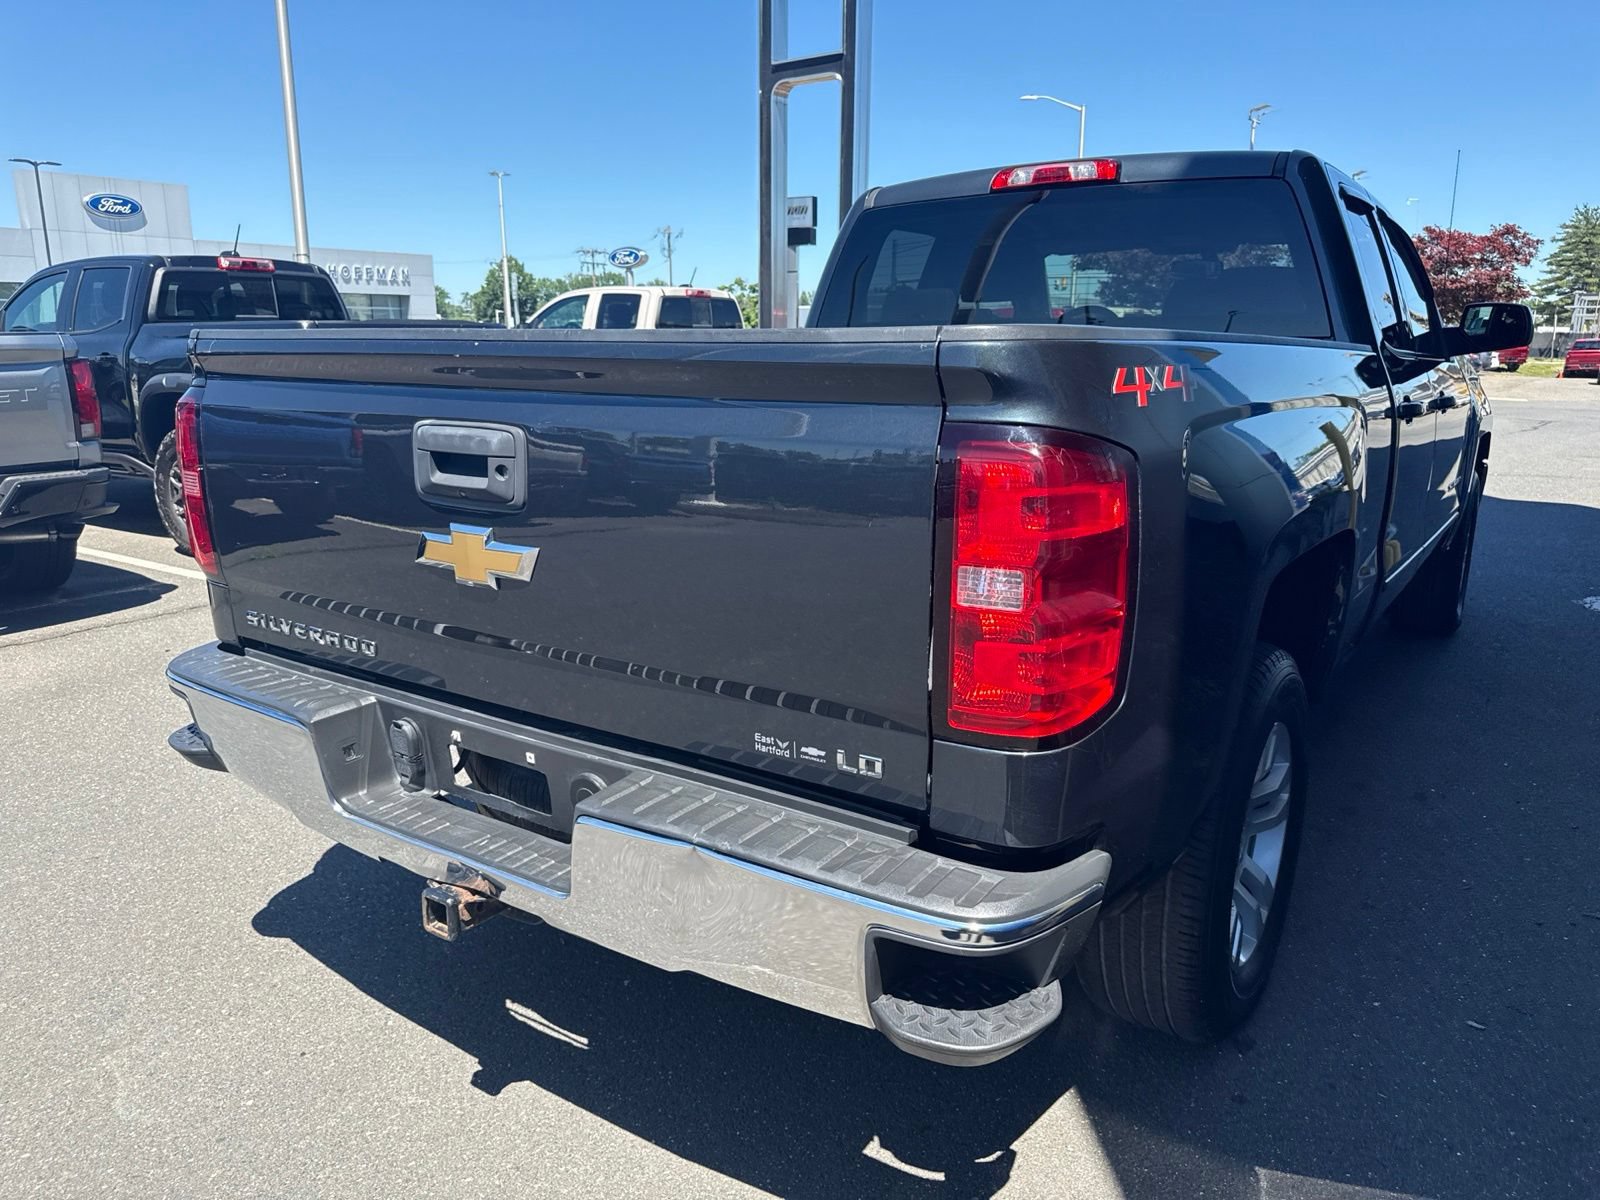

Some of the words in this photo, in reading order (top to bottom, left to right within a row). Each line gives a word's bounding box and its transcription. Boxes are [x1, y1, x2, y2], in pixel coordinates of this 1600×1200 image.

[98, 197, 132, 214] Ford
[327, 263, 411, 282] HOFFMAN
[245, 609, 377, 658] SILVERADO
[754, 732, 775, 745] East
[754, 742, 791, 758] Hartford
[836, 748, 883, 779] LD
